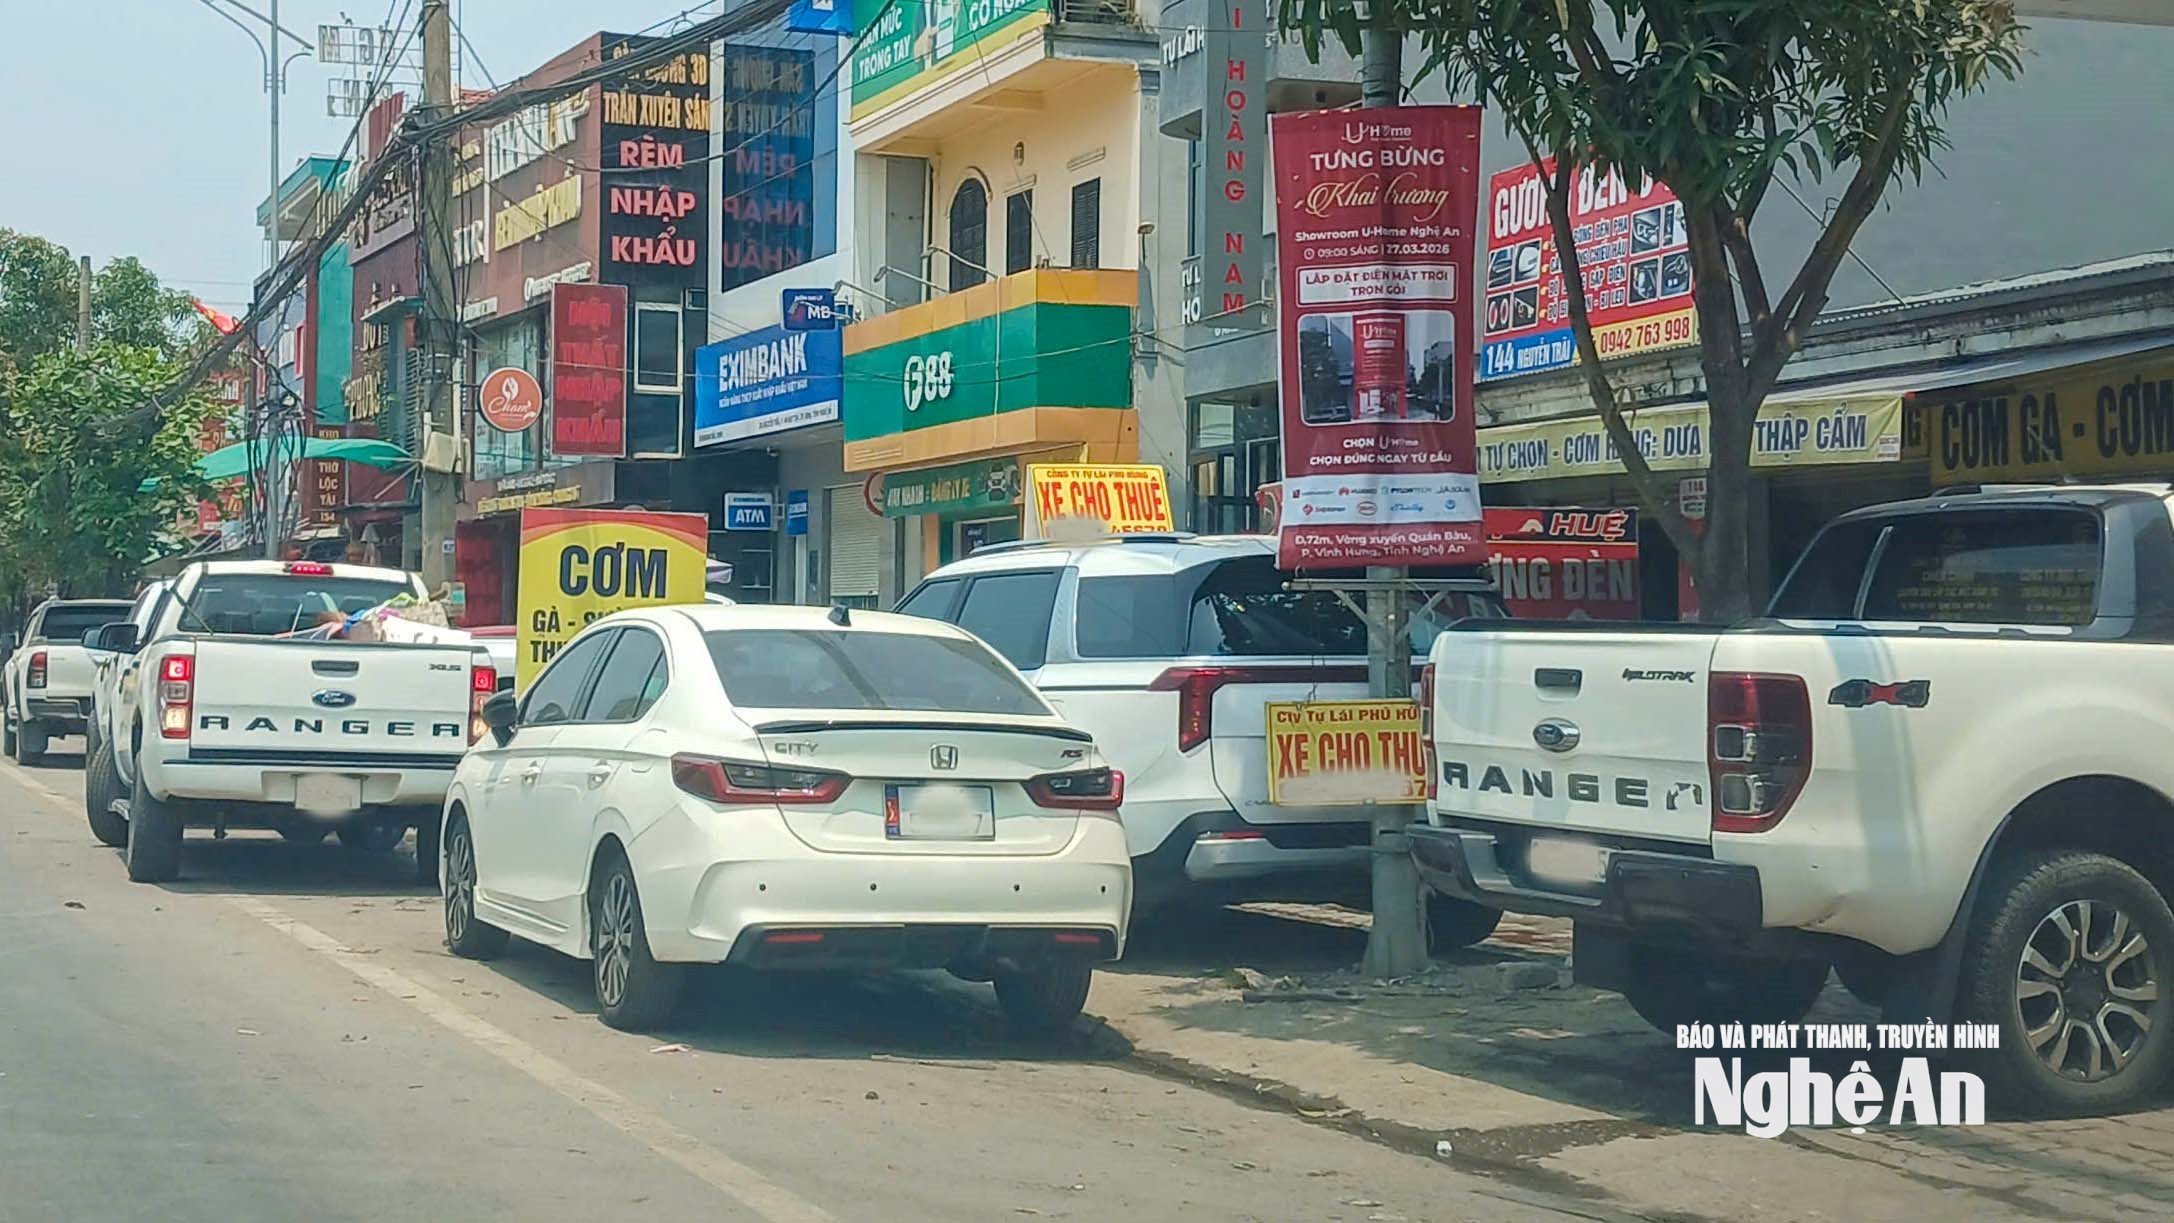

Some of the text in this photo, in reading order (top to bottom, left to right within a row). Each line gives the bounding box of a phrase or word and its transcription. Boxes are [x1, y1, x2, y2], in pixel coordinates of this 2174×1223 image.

[691, 53, 707, 86] 3D
[859, 34, 911, 81] TRONG TAY
[640, 91, 682, 128] XUYÊN
[1224, 60, 1246, 201] HOÀNG
[620, 135, 685, 168] RÈM
[1310, 145, 1445, 171] TƯNG BỪNG
[611, 184, 696, 222] NHẬP
[1306, 172, 1379, 217] Khai
[612, 226, 696, 266] KHẨU
[1295, 229, 1359, 241] Showroom
[1443, 226, 1460, 237] An
[1224, 233, 1244, 315] NAM
[808, 305, 832, 320] MB
[1600, 317, 1690, 354] 0942 763 998
[719, 333, 808, 391] EXIMBANK
[1487, 342, 1512, 375] 144
[904, 352, 953, 411] F88
[1343, 438, 1374, 449] CHỌN
[1486, 441, 1504, 476] TỰ
[1508, 438, 1548, 473] CHỌN
[1564, 431, 1600, 465] CƠM
[1663, 422, 1702, 458] DƯA
[1754, 413, 1808, 460] THẬP
[1816, 402, 1867, 450] CẨM
[1310, 455, 1342, 467] CHỌN
[1377, 454, 1408, 464] NGAY
[736, 509, 765, 523] ATM
[1038, 476, 1166, 521] XE CHO THUÊ
[1549, 509, 1629, 541] HUỆ
[1447, 544, 1465, 554] An
[560, 541, 668, 599] CƠM
[1562, 549, 1633, 600] ĐÈN
[532, 606, 561, 633] GÀ
[200, 715, 460, 737] RANGER
[775, 742, 1083, 758] CITY RS
[1276, 733, 1309, 778] XE
[1319, 732, 1370, 772] CHO
